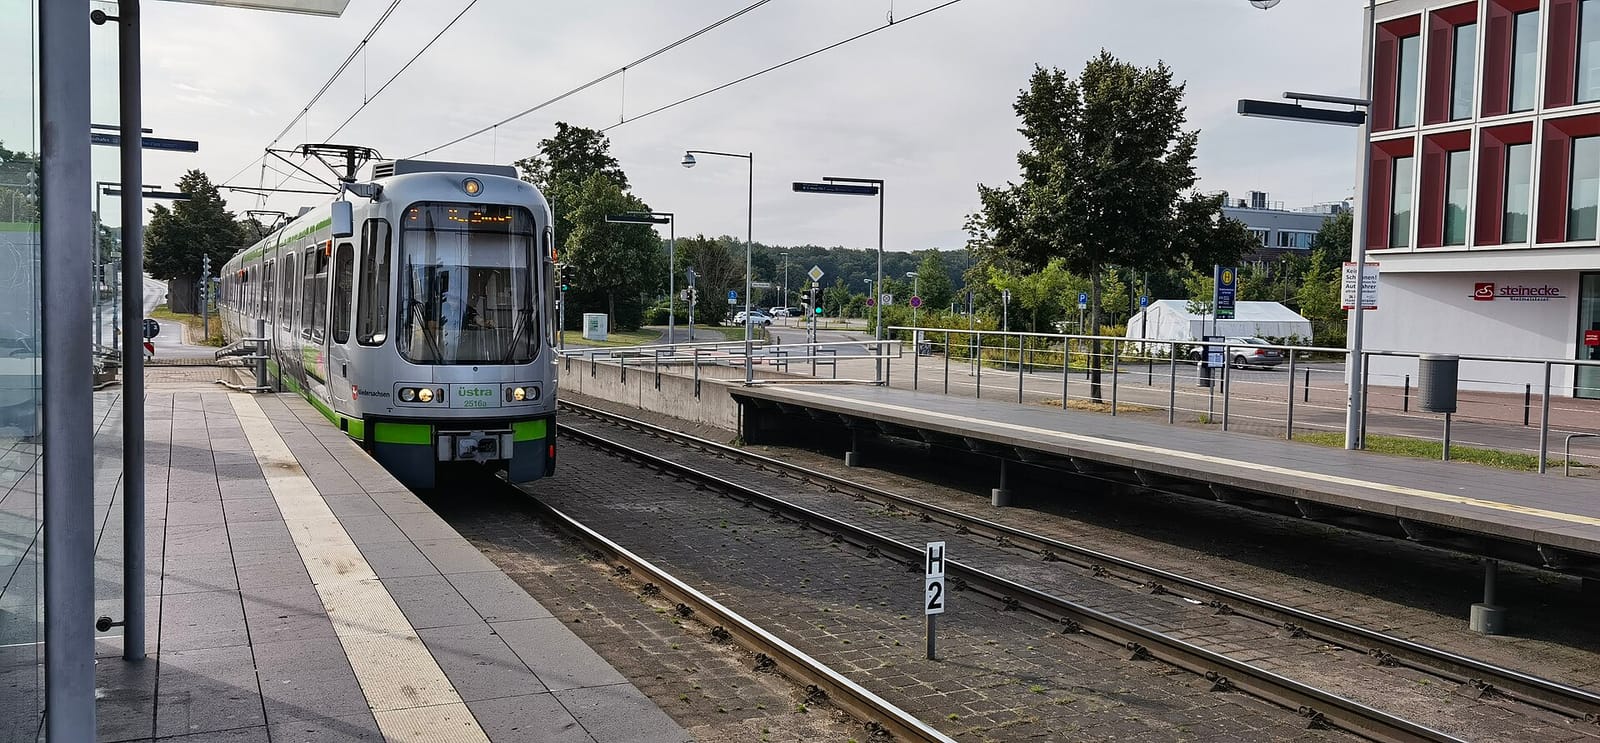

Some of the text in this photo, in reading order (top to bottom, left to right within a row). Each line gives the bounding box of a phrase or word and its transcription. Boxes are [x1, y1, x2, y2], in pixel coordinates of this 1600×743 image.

[1500, 285, 1559, 296] steinecke
[458, 386, 493, 397] üstra
[464, 400, 487, 408] 2516a
[928, 545, 943, 575] H
[927, 581, 942, 609] 2
